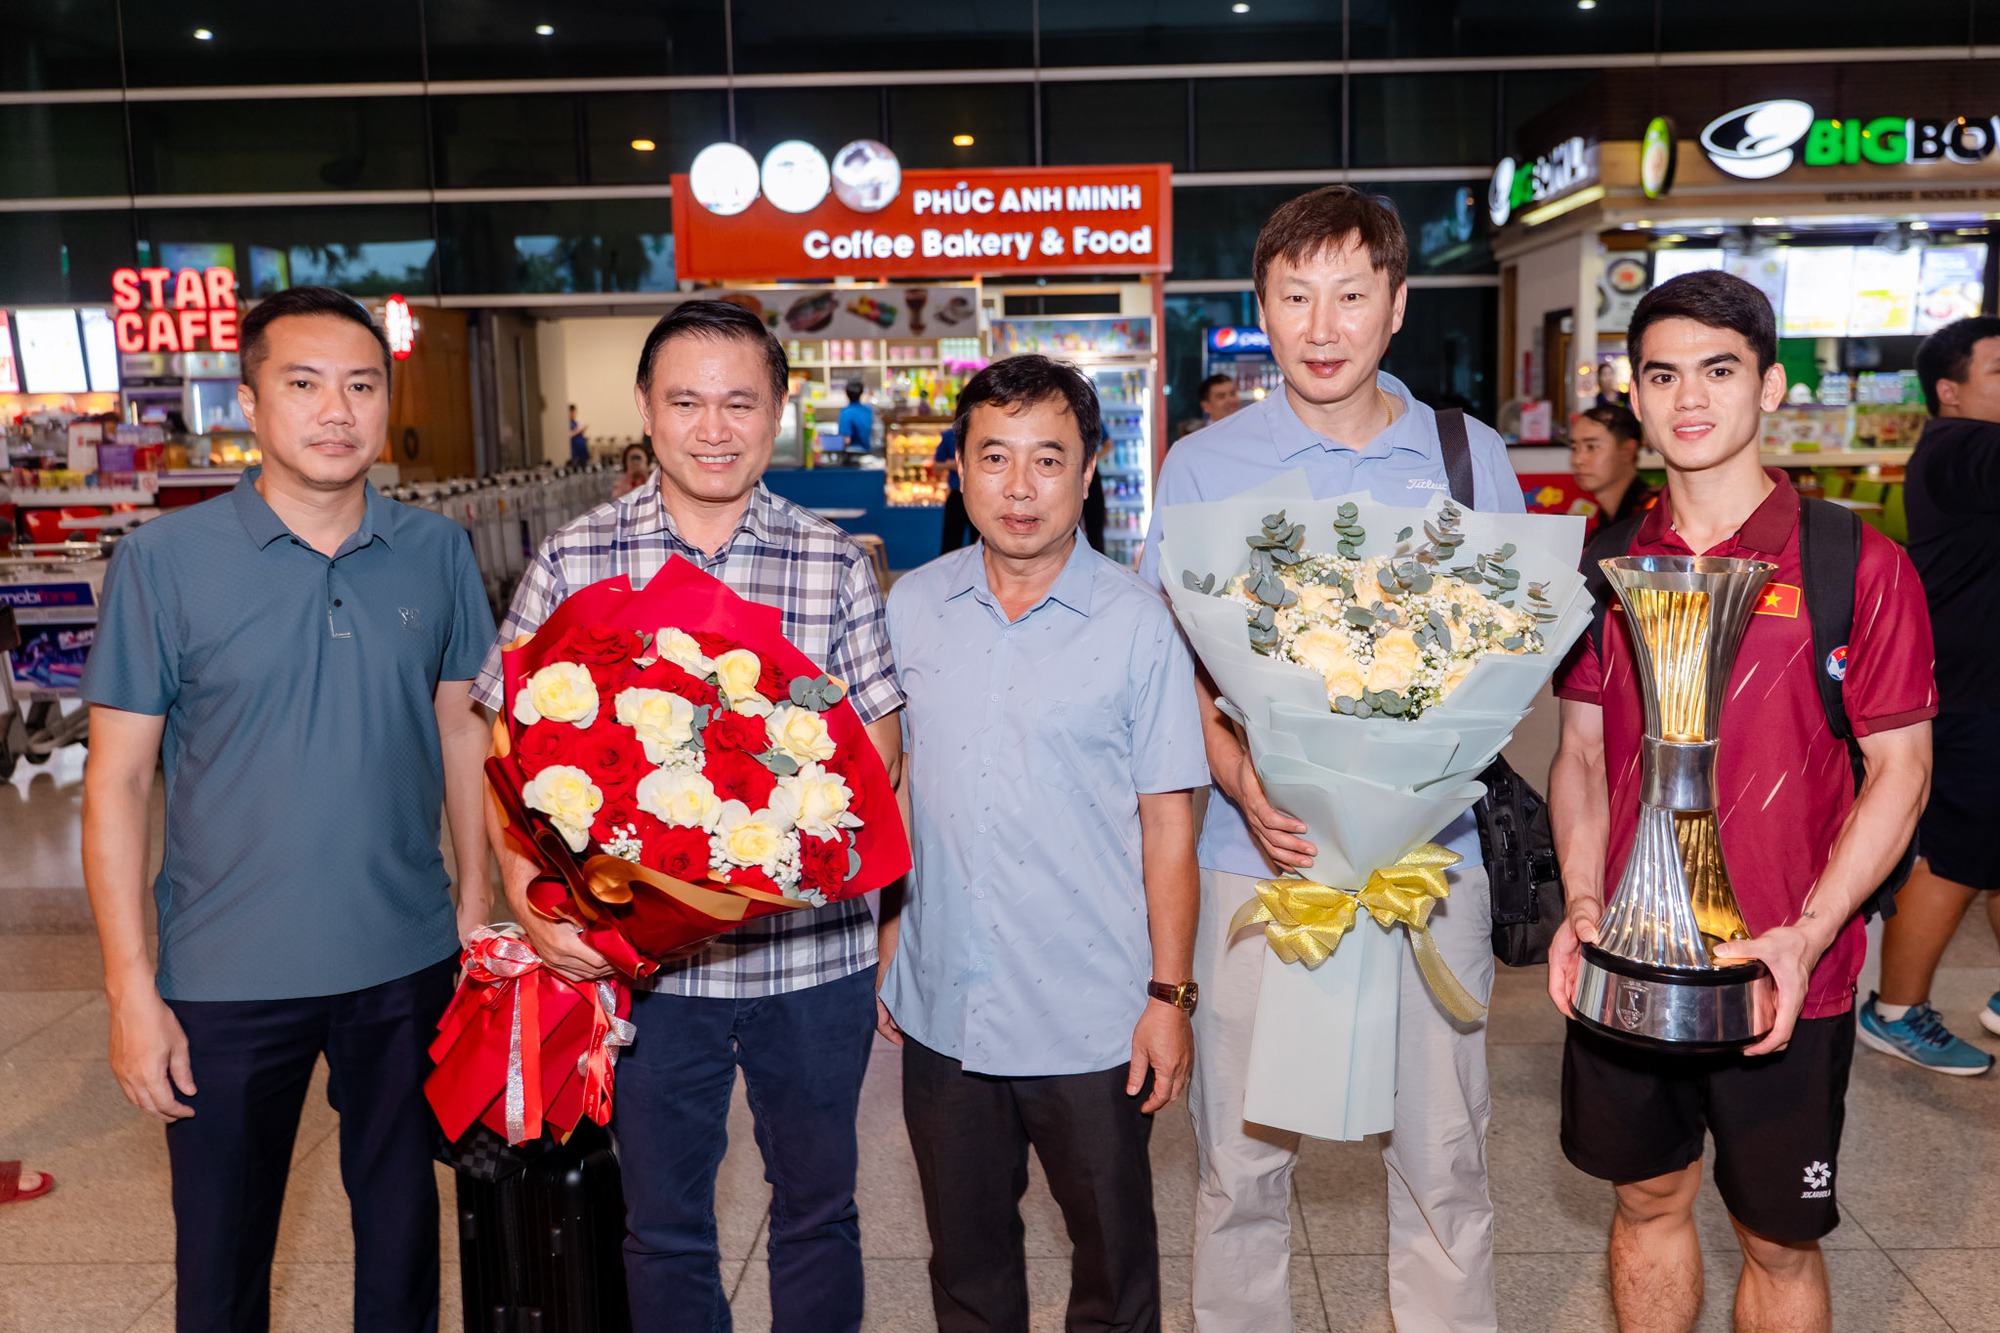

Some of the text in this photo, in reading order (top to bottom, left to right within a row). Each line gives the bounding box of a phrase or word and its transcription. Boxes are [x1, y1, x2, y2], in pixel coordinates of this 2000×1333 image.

[1804, 115, 2000, 165] BIGBO
[913, 181, 1141, 214] PHÚC ANH MINH
[803, 225, 1152, 260] Coffee Bakery & Food
[112, 267, 237, 310] STAR
[116, 310, 239, 353] CAFE
